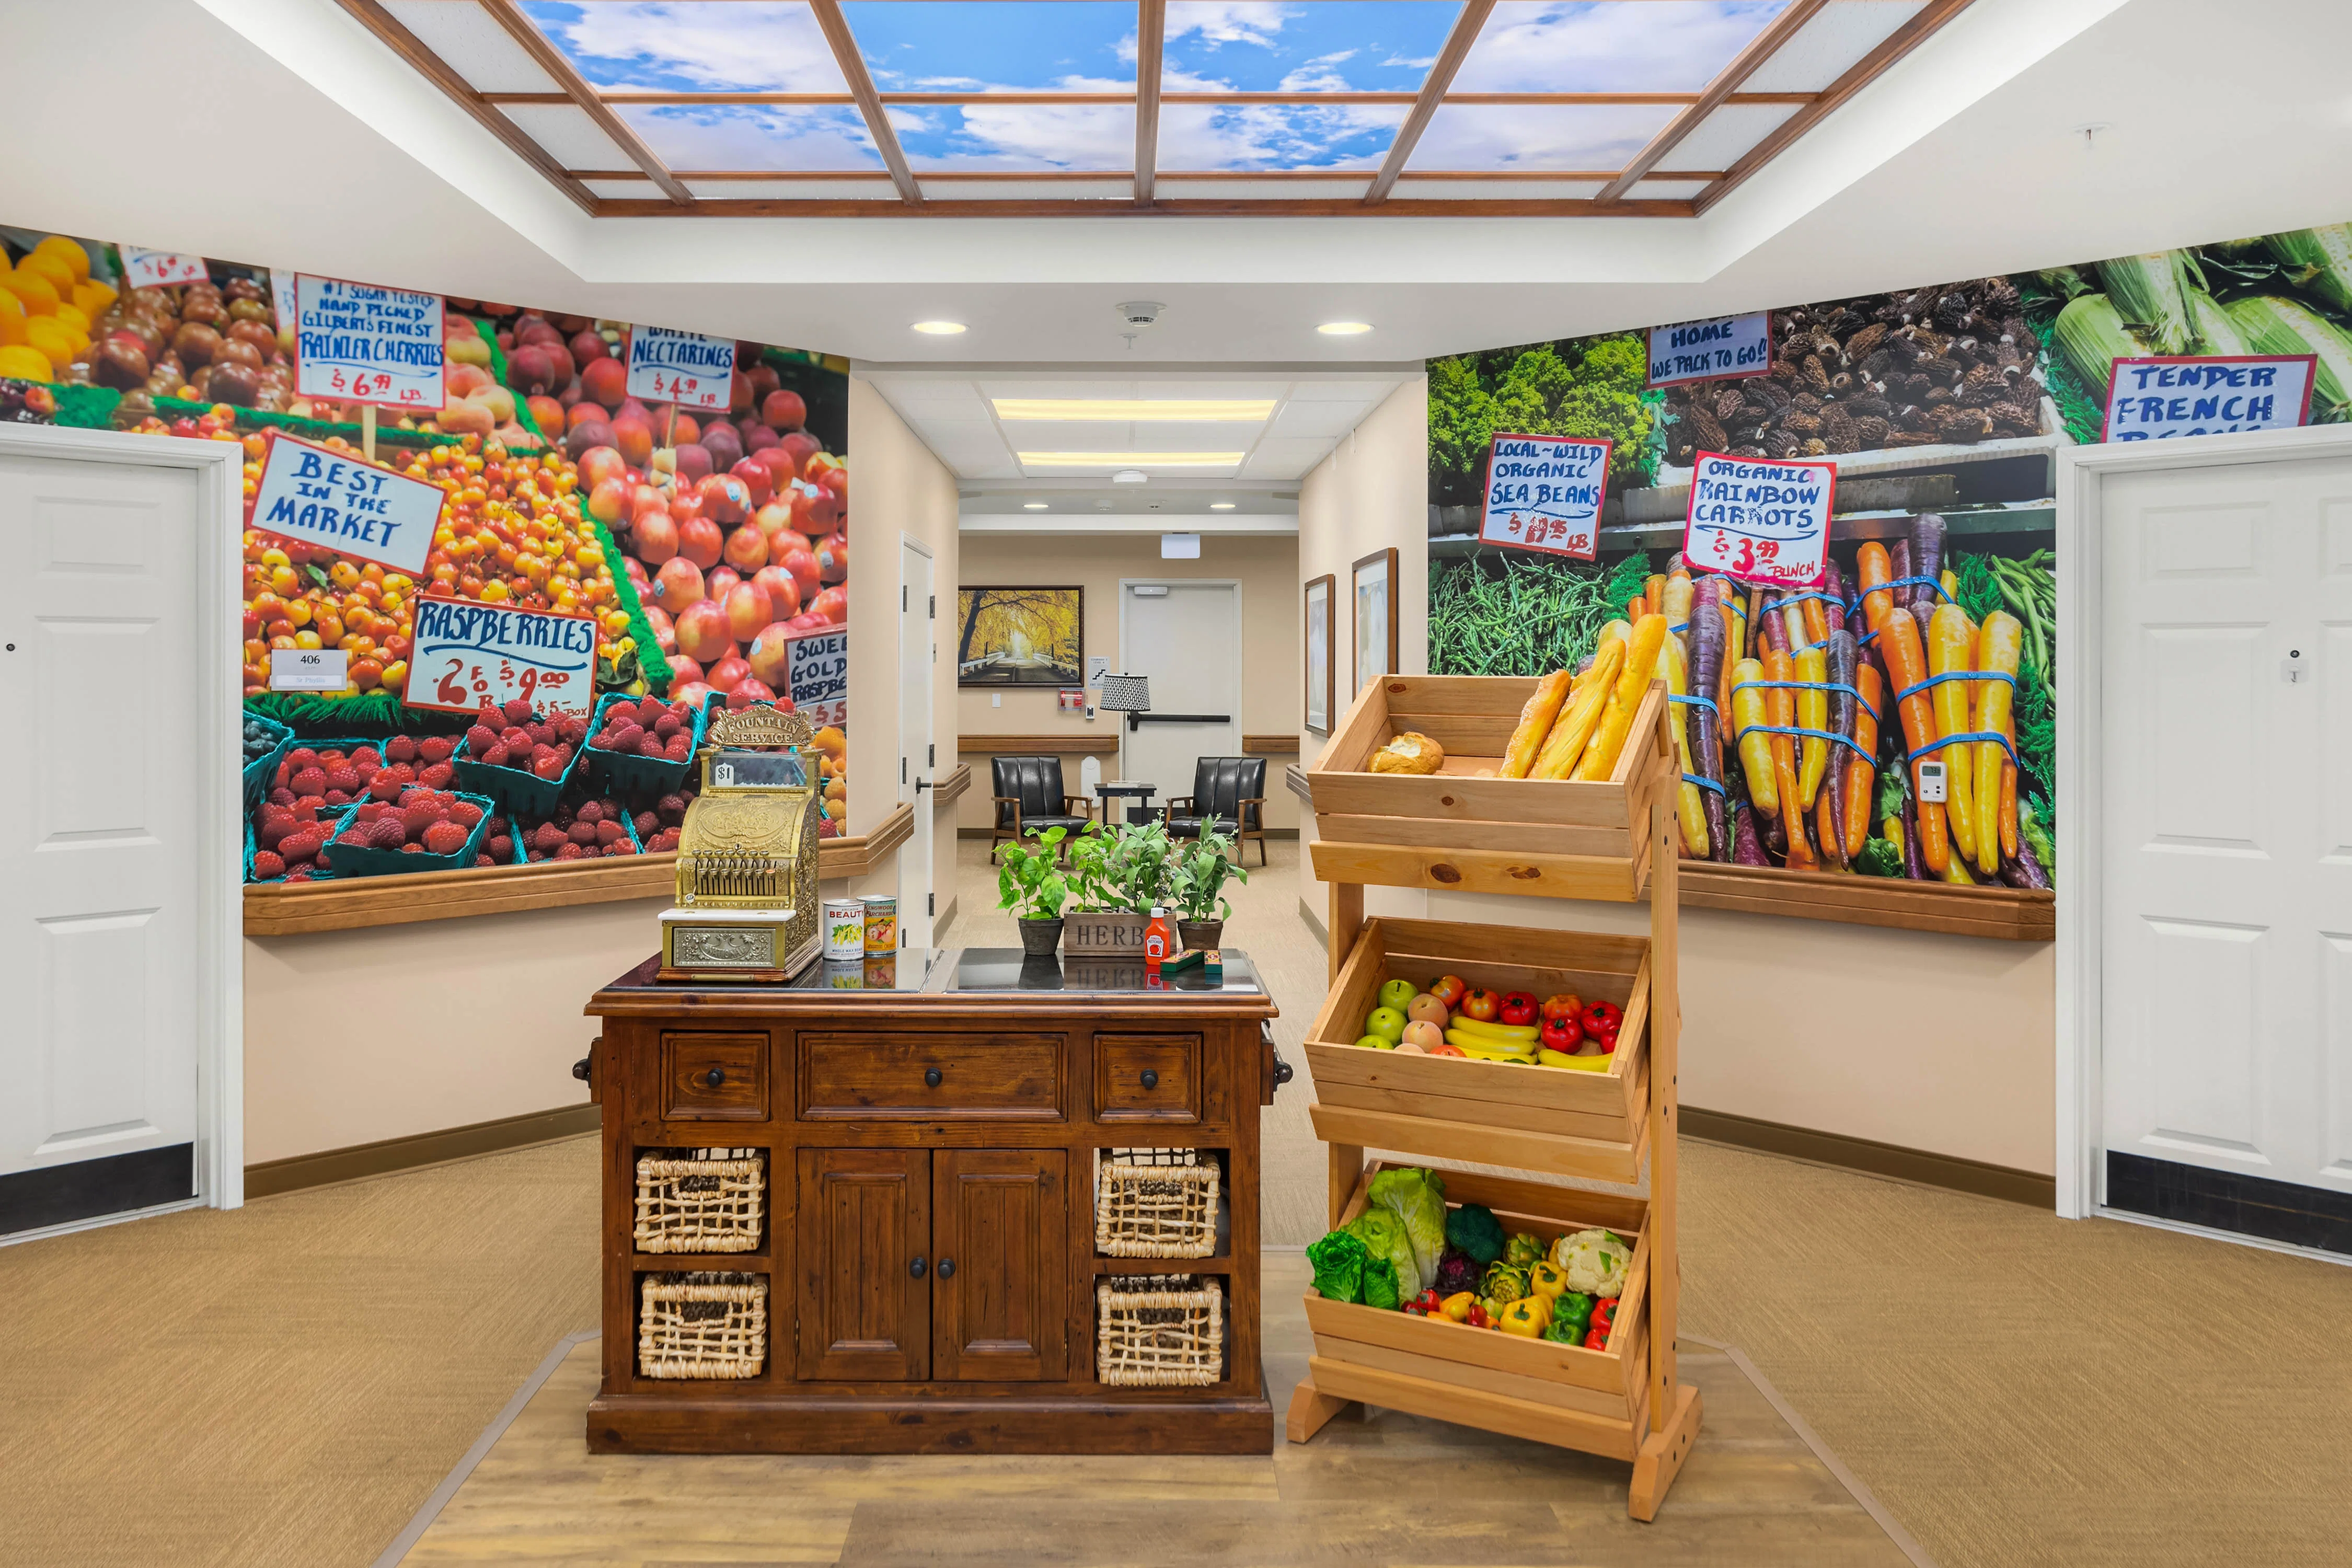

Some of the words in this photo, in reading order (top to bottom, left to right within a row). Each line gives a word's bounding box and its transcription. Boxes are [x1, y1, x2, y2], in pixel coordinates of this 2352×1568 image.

[349, 285, 387, 302] SUGAR
[393, 290, 434, 308] TESTED
[319, 298, 360, 314] HAND
[365, 303, 424, 322] PICKED
[378, 320, 433, 337] FINEST
[1670, 321, 1733, 349] HOME
[298, 332, 371, 361] RAINIER
[373, 339, 443, 366] CHERRIES
[632, 339, 732, 368] NECTARINES
[1651, 359, 1672, 379] WE
[1674, 352, 1710, 374] PACK
[1715, 349, 1732, 368] TO
[2131, 365, 2277, 390] TENDER
[2117, 395, 2274, 424] FRENCH
[291, 452, 389, 494] BEST
[1495, 462, 1588, 479] ORGANIC
[1708, 461, 1814, 483] ORGANIC
[296, 482, 331, 500] IN
[345, 493, 391, 514] THE
[1491, 482, 1529, 505] SEA
[1535, 483, 1600, 508] BEANS
[1697, 479, 1820, 506] RAINBOW
[266, 497, 402, 547] MARKET
[1695, 504, 1813, 528] CARROTS
[1768, 560, 1815, 577] BUNCH
[417, 602, 593, 653] RASPBERRIES
[300, 654, 320, 664] 406
[727, 716, 800, 733] FOUNTAIN
[732, 733, 793, 744] SERVICE
[718, 766, 730, 780] $1
